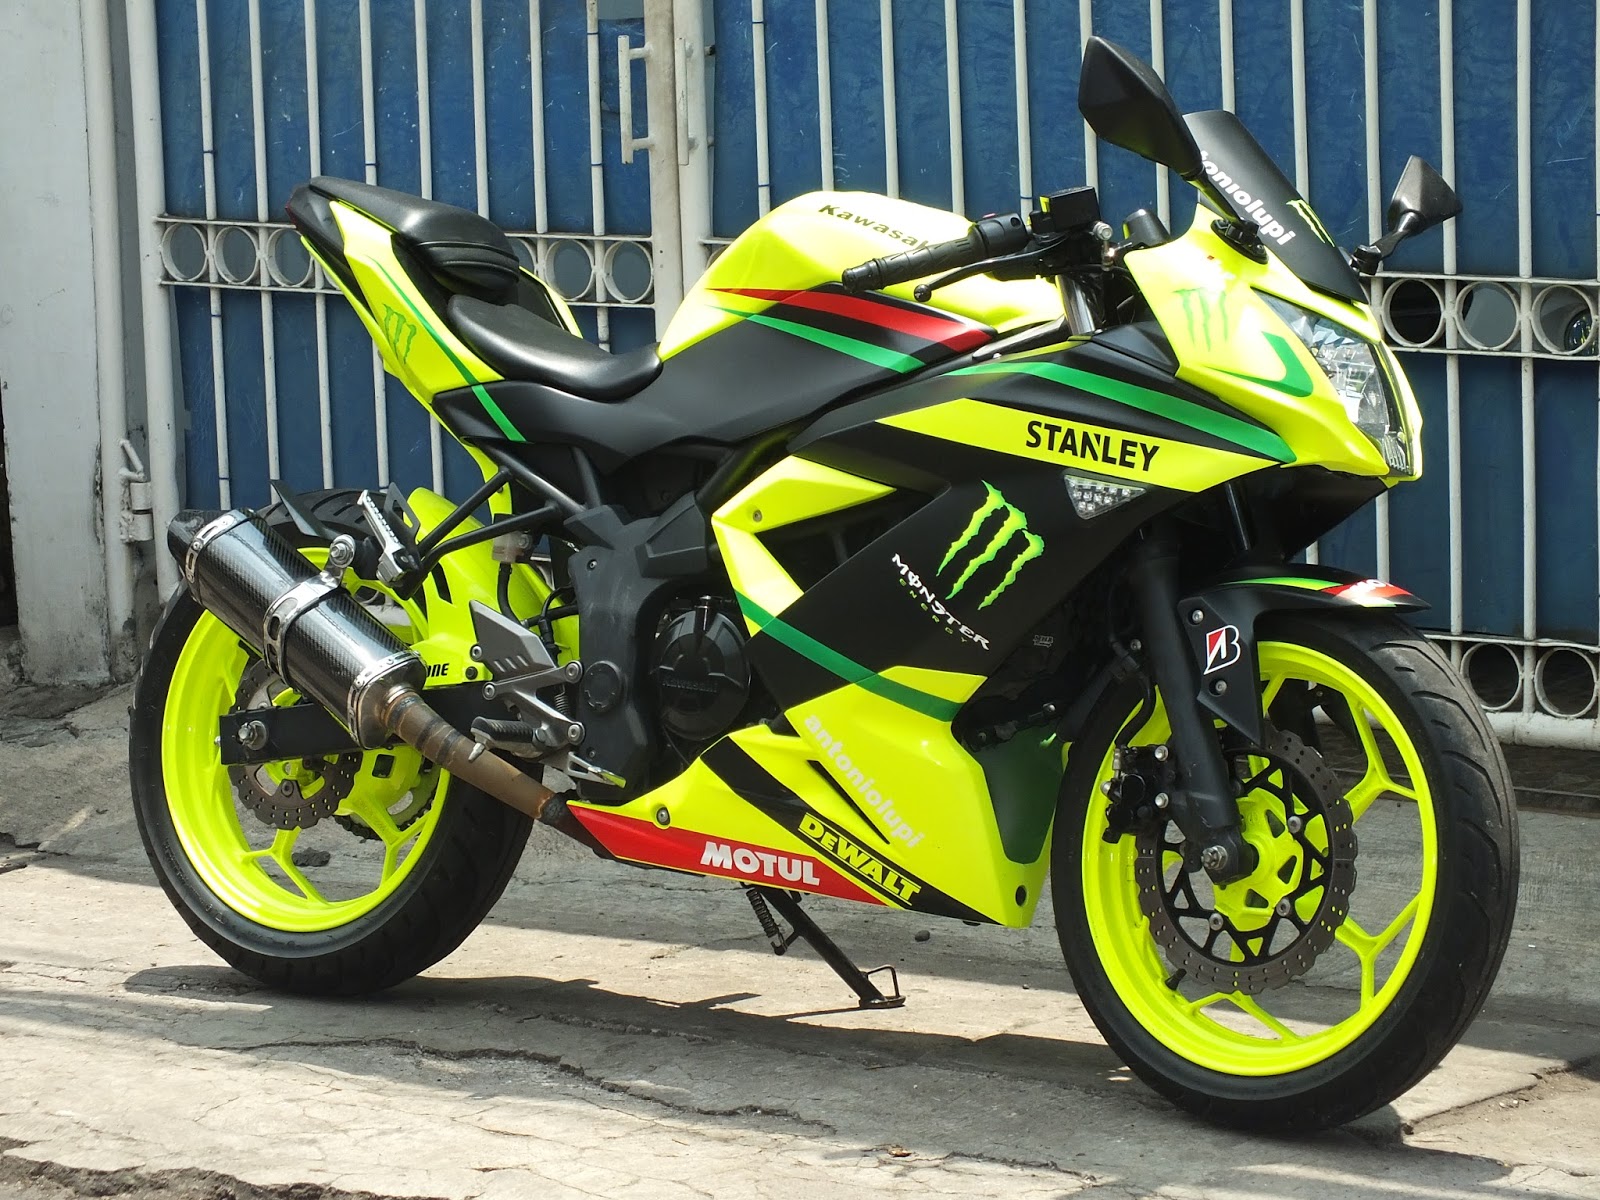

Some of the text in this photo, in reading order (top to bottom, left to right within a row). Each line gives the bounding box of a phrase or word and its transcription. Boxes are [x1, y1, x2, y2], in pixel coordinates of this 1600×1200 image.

[1026, 421, 1159, 471] STANLEY
[892, 553, 989, 650] MONSTER
[899, 578, 968, 642] ENERGY
[804, 714, 925, 848] antoniolupi
[700, 841, 820, 886] MOTUL
[800, 815, 922, 901] DEWALT
